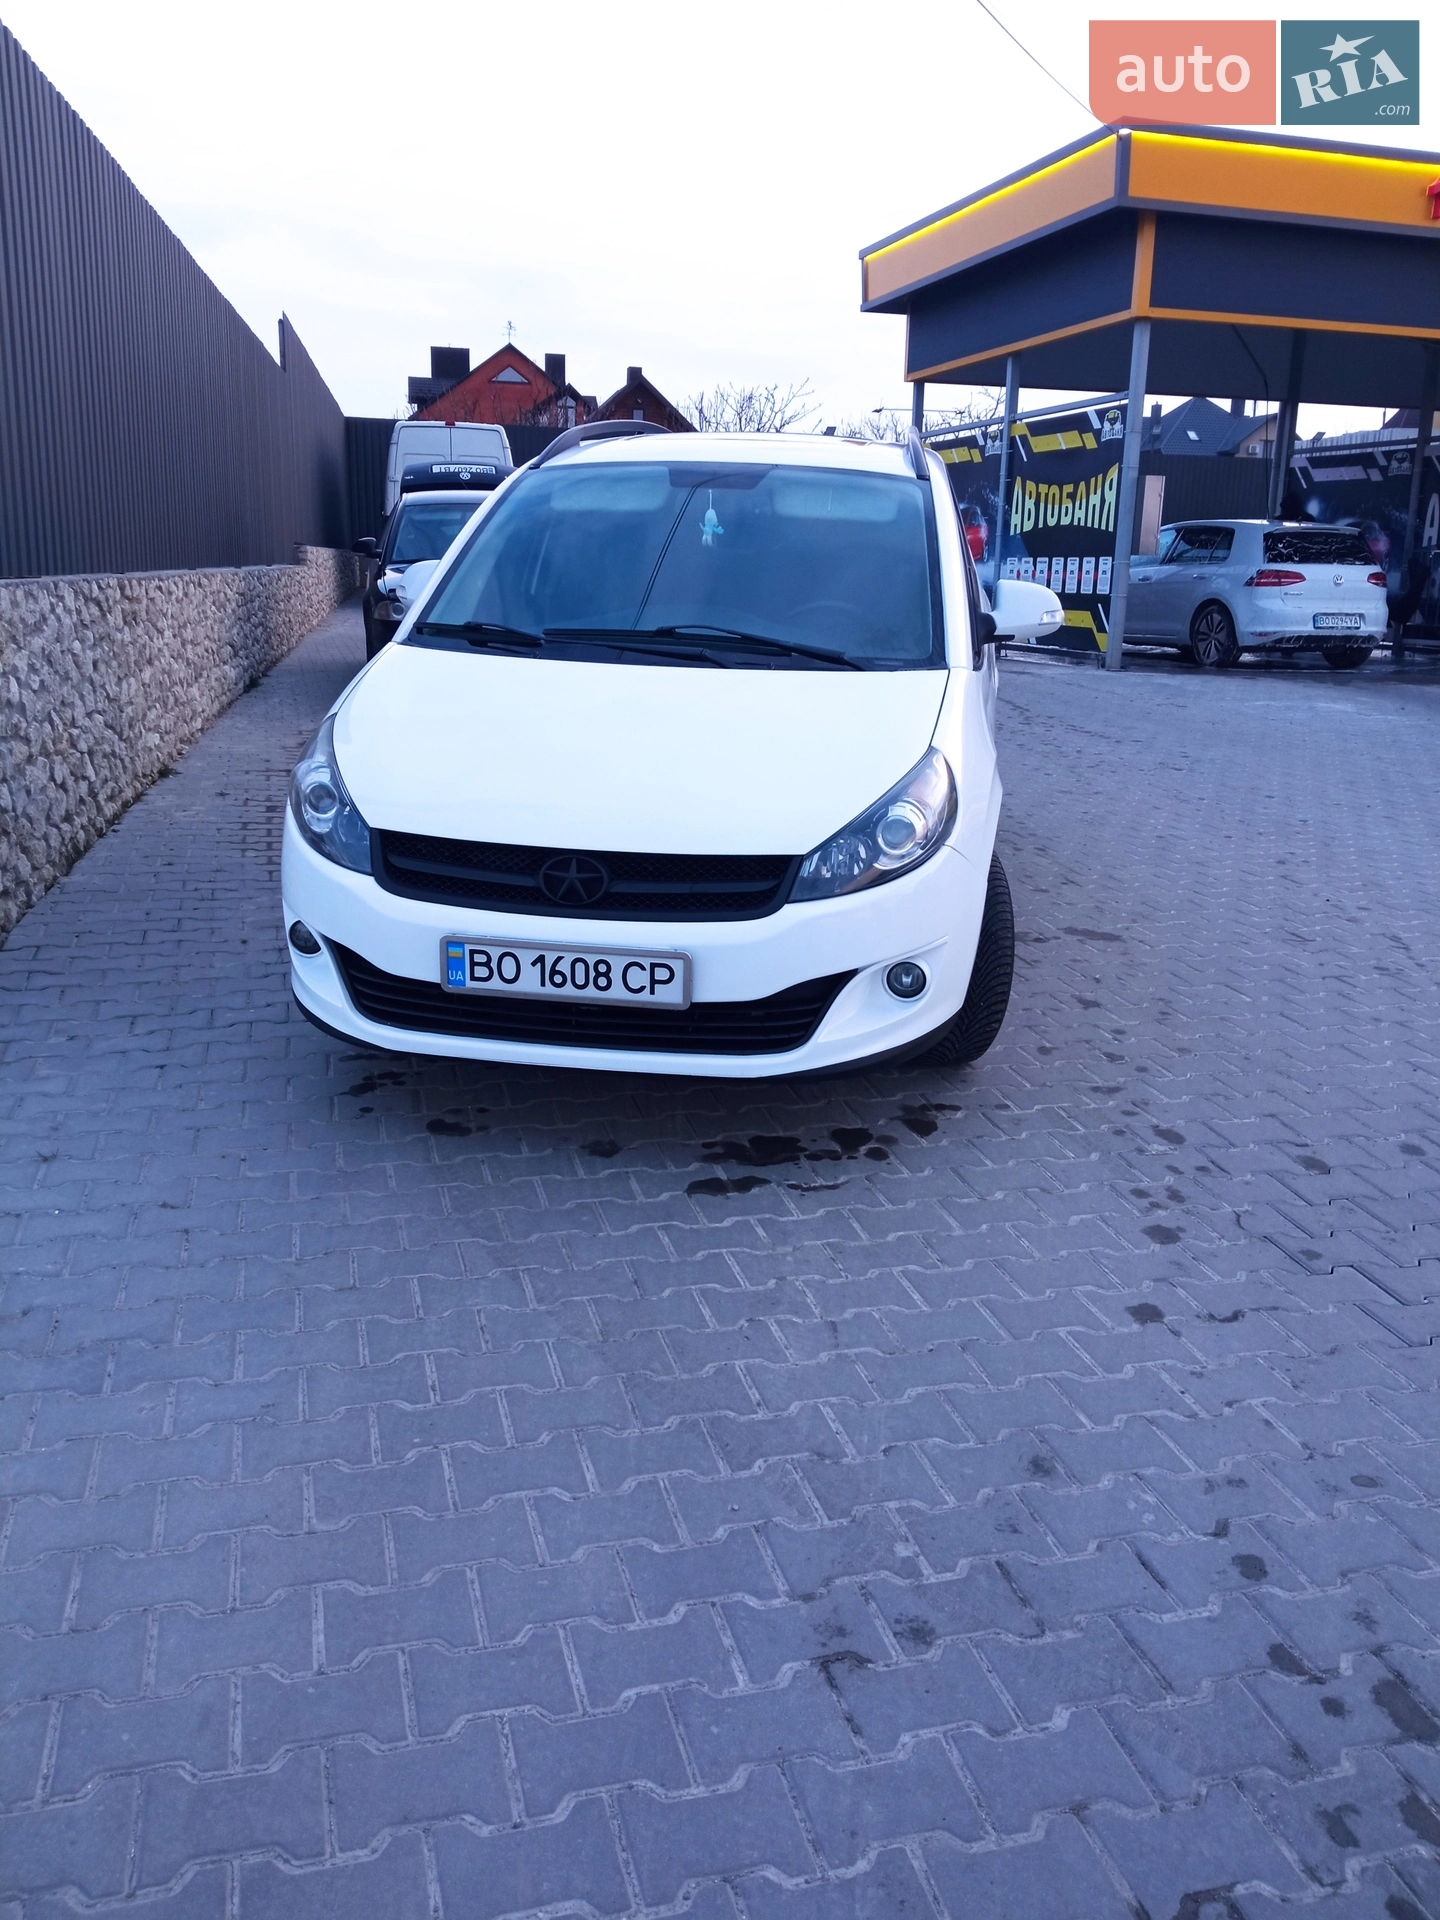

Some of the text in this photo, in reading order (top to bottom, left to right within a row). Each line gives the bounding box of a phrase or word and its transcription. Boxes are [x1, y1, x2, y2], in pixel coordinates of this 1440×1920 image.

[1009, 462, 1119, 536] АВТОБАНЯ
[448, 969, 464, 981] UA
[468, 948, 675, 996] BO 1608 CP
